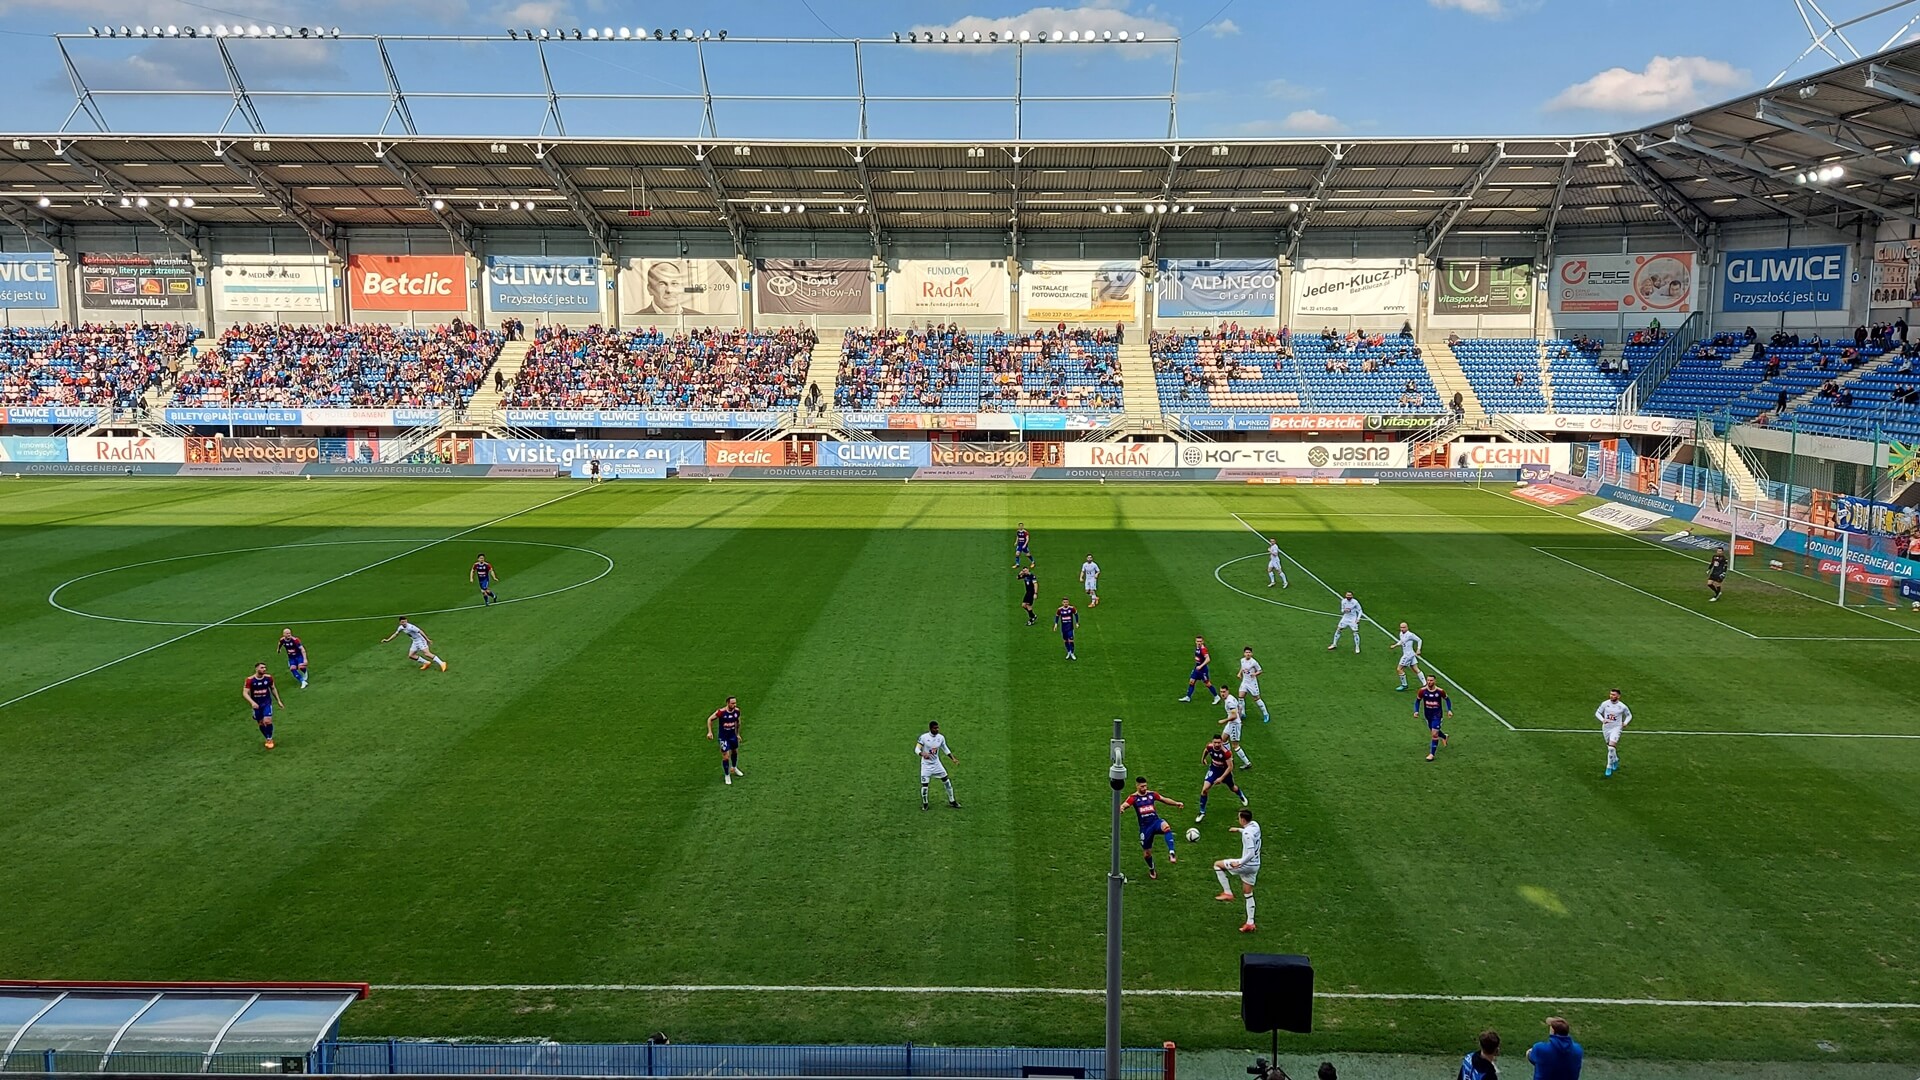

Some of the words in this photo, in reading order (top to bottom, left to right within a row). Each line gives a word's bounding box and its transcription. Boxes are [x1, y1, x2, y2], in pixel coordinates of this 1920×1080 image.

[1878, 244, 1918, 260] GLIWICE
[119, 266, 138, 276] litery
[490, 263, 596, 286] GLIWICE
[927, 266, 970, 275] FUNDACJA
[1727, 255, 1841, 284] GLIWICE
[1588, 271, 1630, 279] PEC
[363, 271, 453, 295] Betclic
[805, 276, 839, 287] Toyota
[1303, 264, 1407, 298] Jeden-Klucz.pl
[714, 283, 730, 291] 2019
[13, 290, 33, 302] jest
[35, 290, 47, 300] tu
[806, 288, 862, 297] Ja-Now-An
[1219, 292, 1275, 300] Cleaning
[110, 296, 168, 307] www.noviu.pl
[499, 291, 554, 305] Przyszłość
[554, 294, 574, 305] jest
[576, 293, 588, 304] tu
[1438, 294, 1489, 304] vitasport.pl
[1733, 292, 1791, 306] Przyszłość
[1792, 292, 1814, 304] jest
[1816, 292, 1830, 302] tu
[10, 408, 50, 418] GLIWICE
[54, 409, 95, 418] GLIWICE
[171, 411, 297, 422] BILETY@PIAST-GLIWICE.EU
[395, 410, 435, 419] GLIWICE
[508, 412, 549, 420] GLIWICE
[554, 412, 595, 420] GLIWICE
[600, 412, 640, 420] GLIWICE
[646, 412, 685, 421] GLIWICE
[690, 412, 730, 422] GLIWICE
[736, 413, 775, 422] GLIWICE
[846, 414, 885, 423] GLIWICE
[1270, 417, 1316, 429] Betclic
[1316, 417, 1362, 429] Betclic
[1382, 416, 1450, 428] vitasport.pl
[222, 446, 319, 464] verocargo
[507, 442, 670, 467] visit.gliwice.eu
[717, 450, 772, 464] Betclic
[838, 444, 911, 460] GLIWICE
[1470, 446, 1550, 464] CECHINI
[932, 451, 1027, 466] verocargo
[26, 464, 142, 473] #ODNOWAREGENERACJA
[334, 466, 452, 474] #ODNOWAREGENERACJA
[763, 468, 878, 476] #ODNOWAREGENERACJA
[1065, 470, 1181, 478] #ODNOWAREGENERACJA
[1374, 471, 1494, 479] #ODNOWAREGENERACJA
[1613, 490, 1675, 513] #ODNOWAREGENERACJA
[1822, 563, 1859, 573] Betlic
